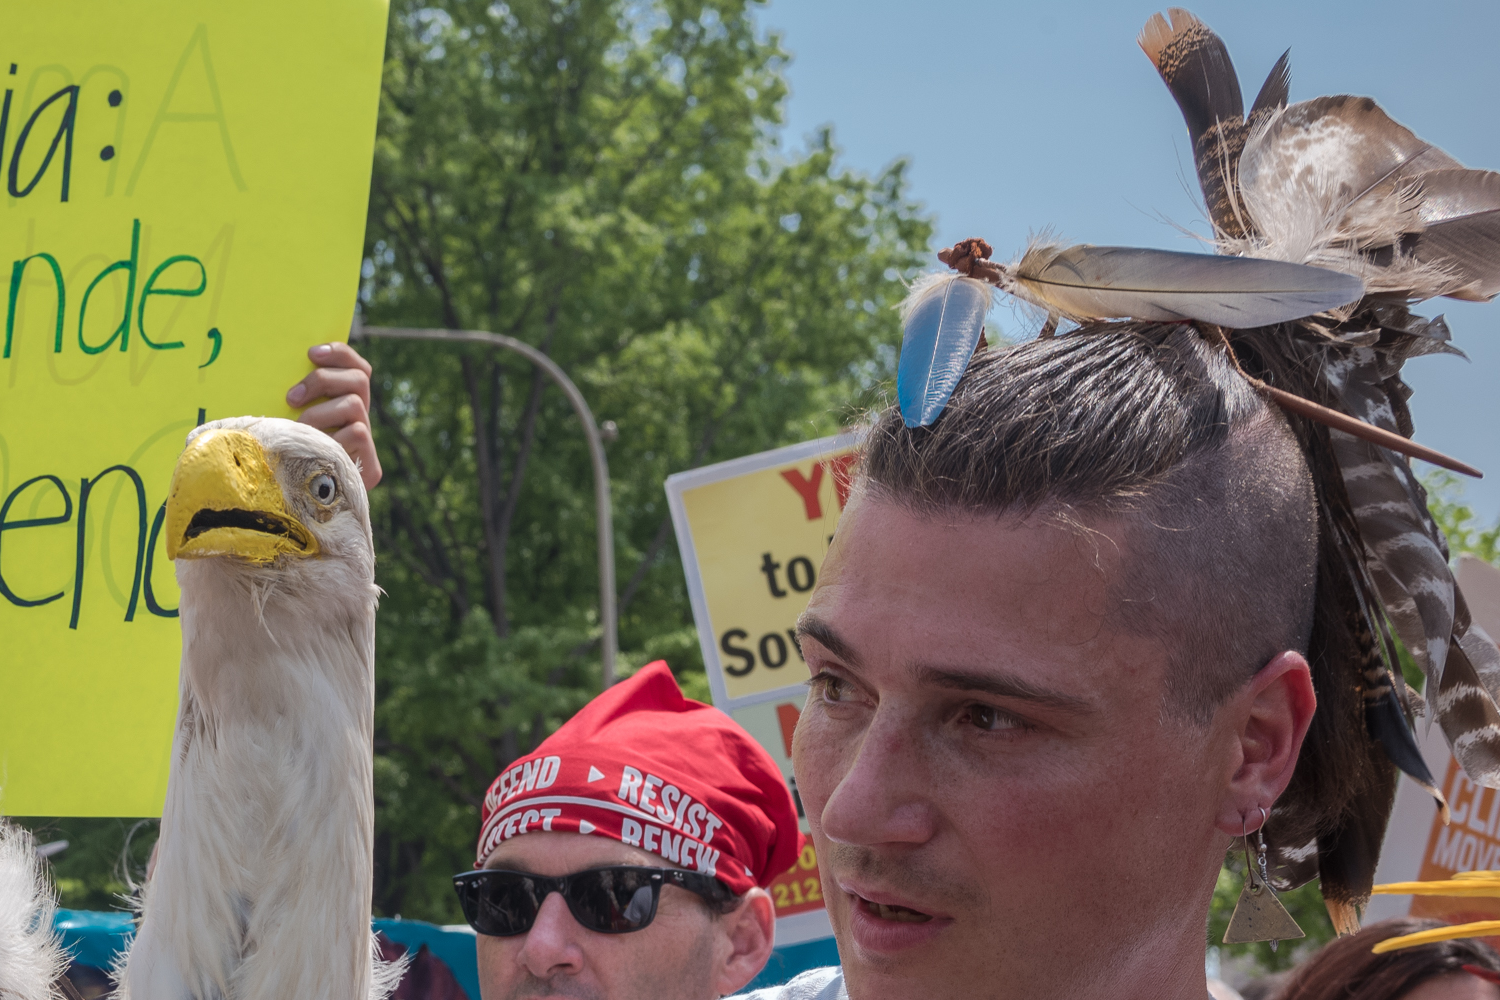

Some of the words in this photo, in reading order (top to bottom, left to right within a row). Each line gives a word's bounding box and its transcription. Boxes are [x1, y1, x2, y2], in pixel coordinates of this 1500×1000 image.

[761, 552, 817, 598] to
[485, 755, 561, 814] DEFEND
[617, 765, 723, 844] RESIST
[1447, 767, 1500, 840] CLI
[621, 817, 720, 877] RENEW
